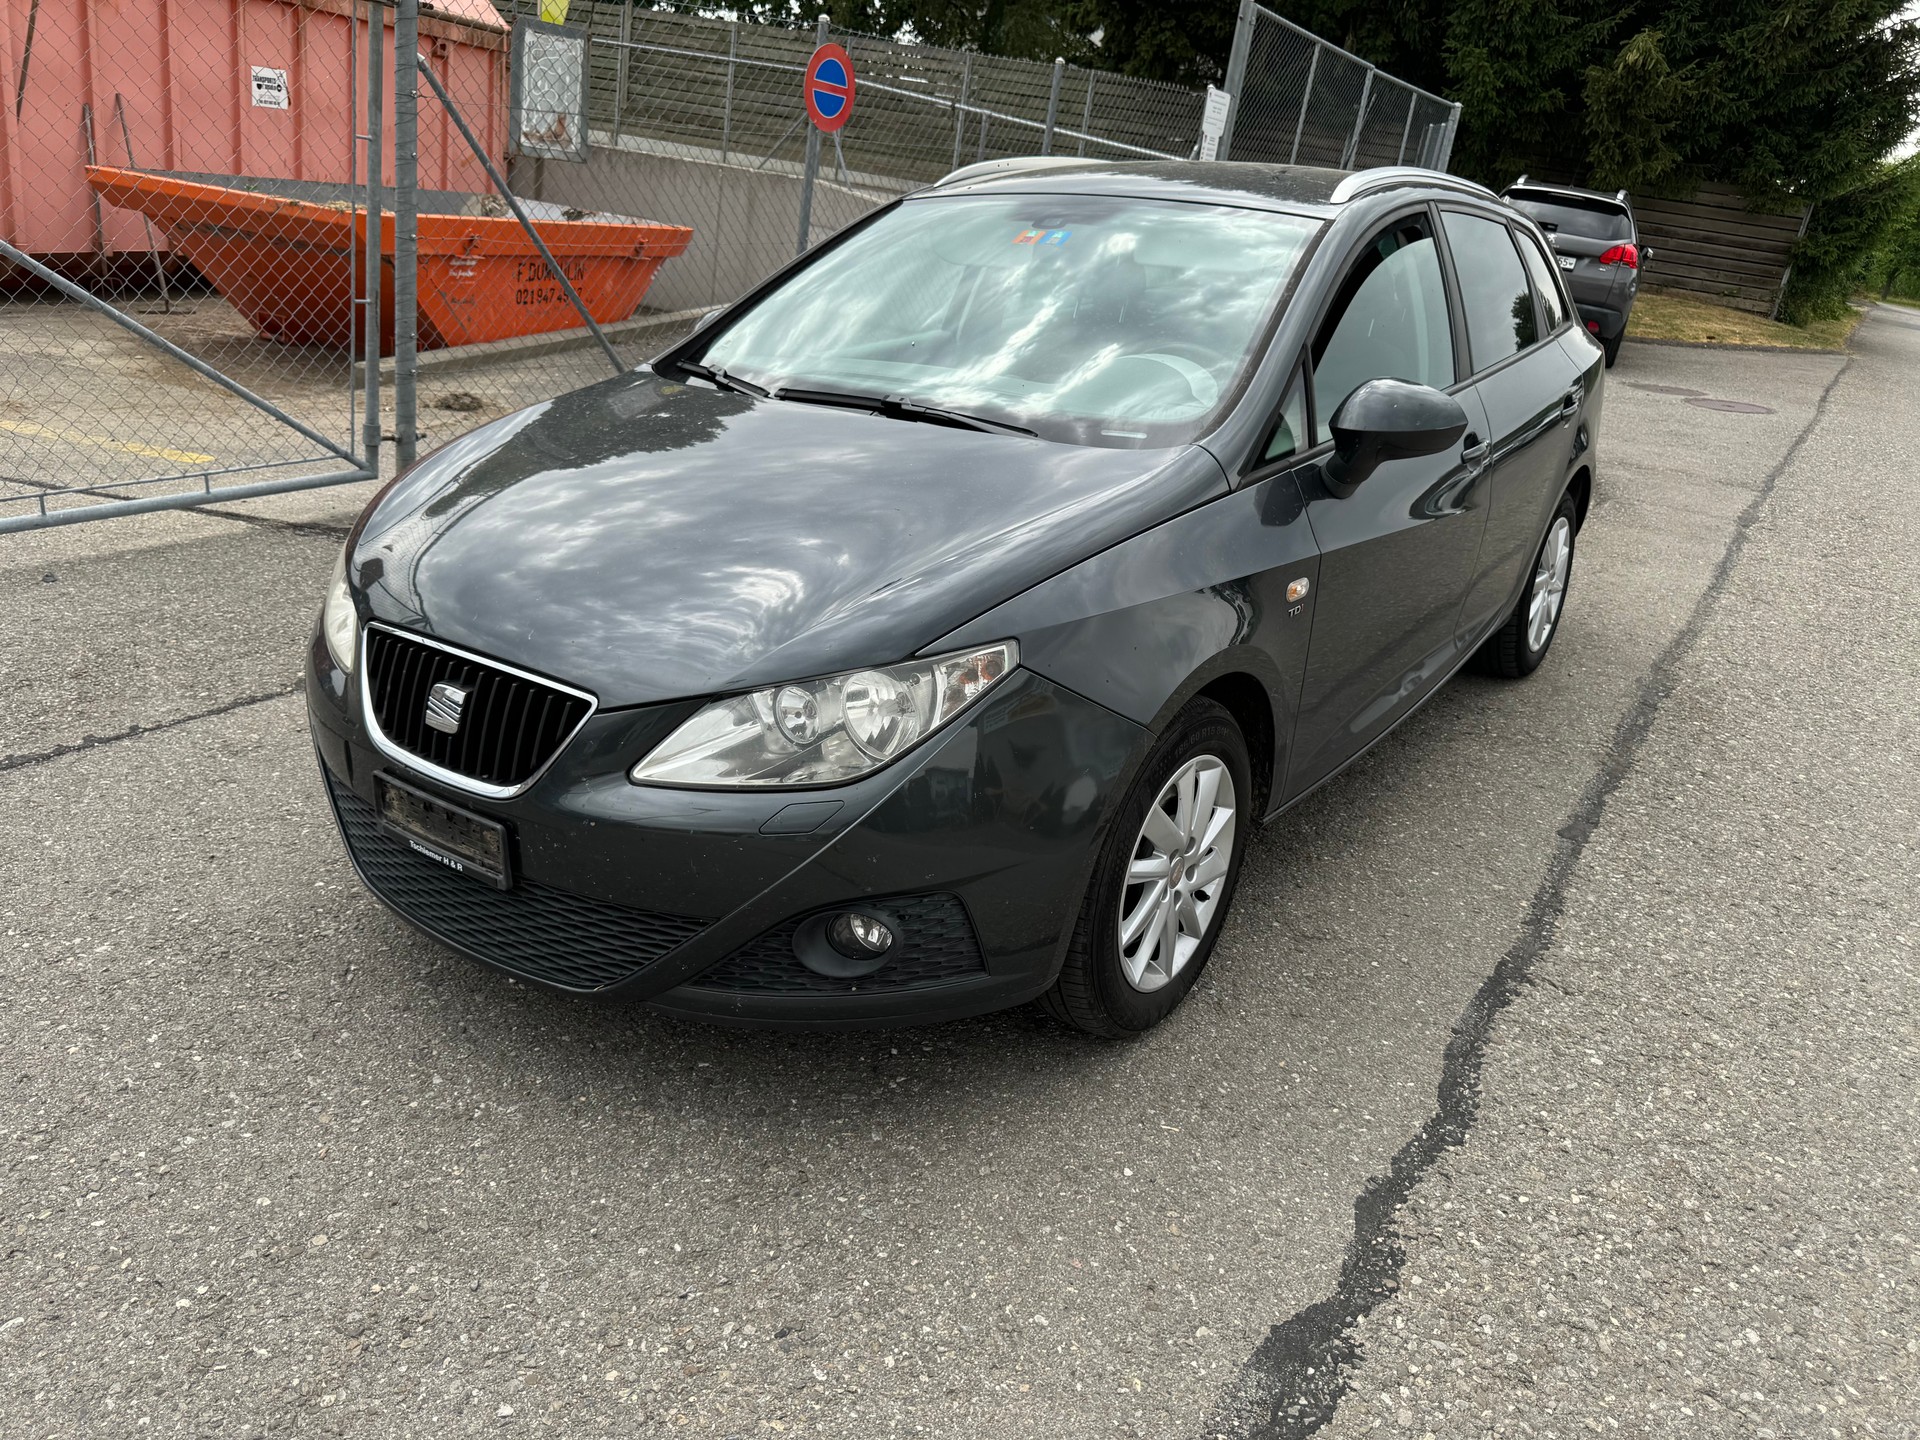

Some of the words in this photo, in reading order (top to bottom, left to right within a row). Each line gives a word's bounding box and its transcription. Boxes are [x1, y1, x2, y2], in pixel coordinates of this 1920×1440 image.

[1288, 603, 1304, 617] TDI
[443, 856, 450, 866] H
[450, 860, 457, 869] &
[457, 863, 464, 872] R
